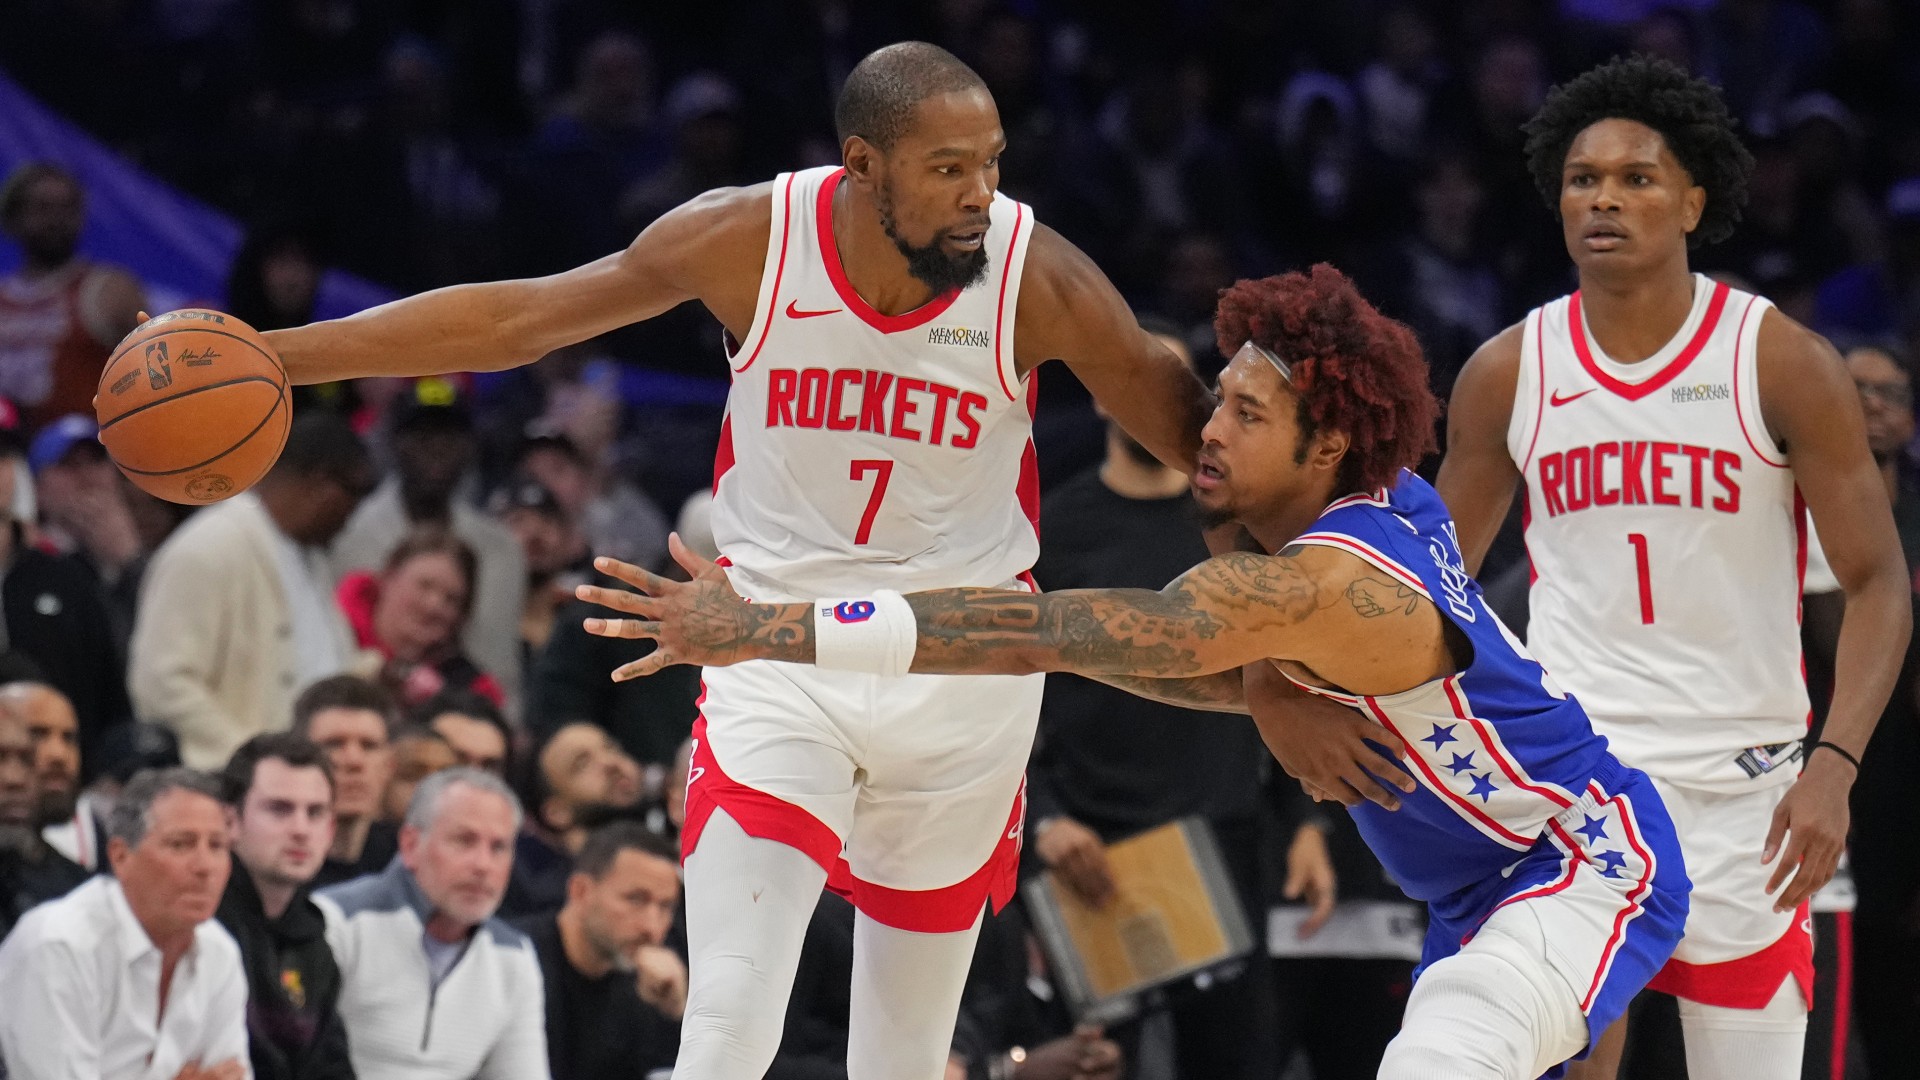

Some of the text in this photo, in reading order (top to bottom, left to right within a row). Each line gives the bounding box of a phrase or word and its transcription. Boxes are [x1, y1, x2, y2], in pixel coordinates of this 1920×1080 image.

[928, 335, 989, 348] HERMANN
[929, 327, 989, 341] MEMORIAL
[765, 367, 988, 449] ROCKETS
[1671, 384, 1729, 396] MEMORIAL
[1671, 390, 1729, 403] HERMANN
[1538, 440, 1742, 518] ROCKETS
[849, 460, 894, 545] 7
[1627, 533, 1655, 625] 1
